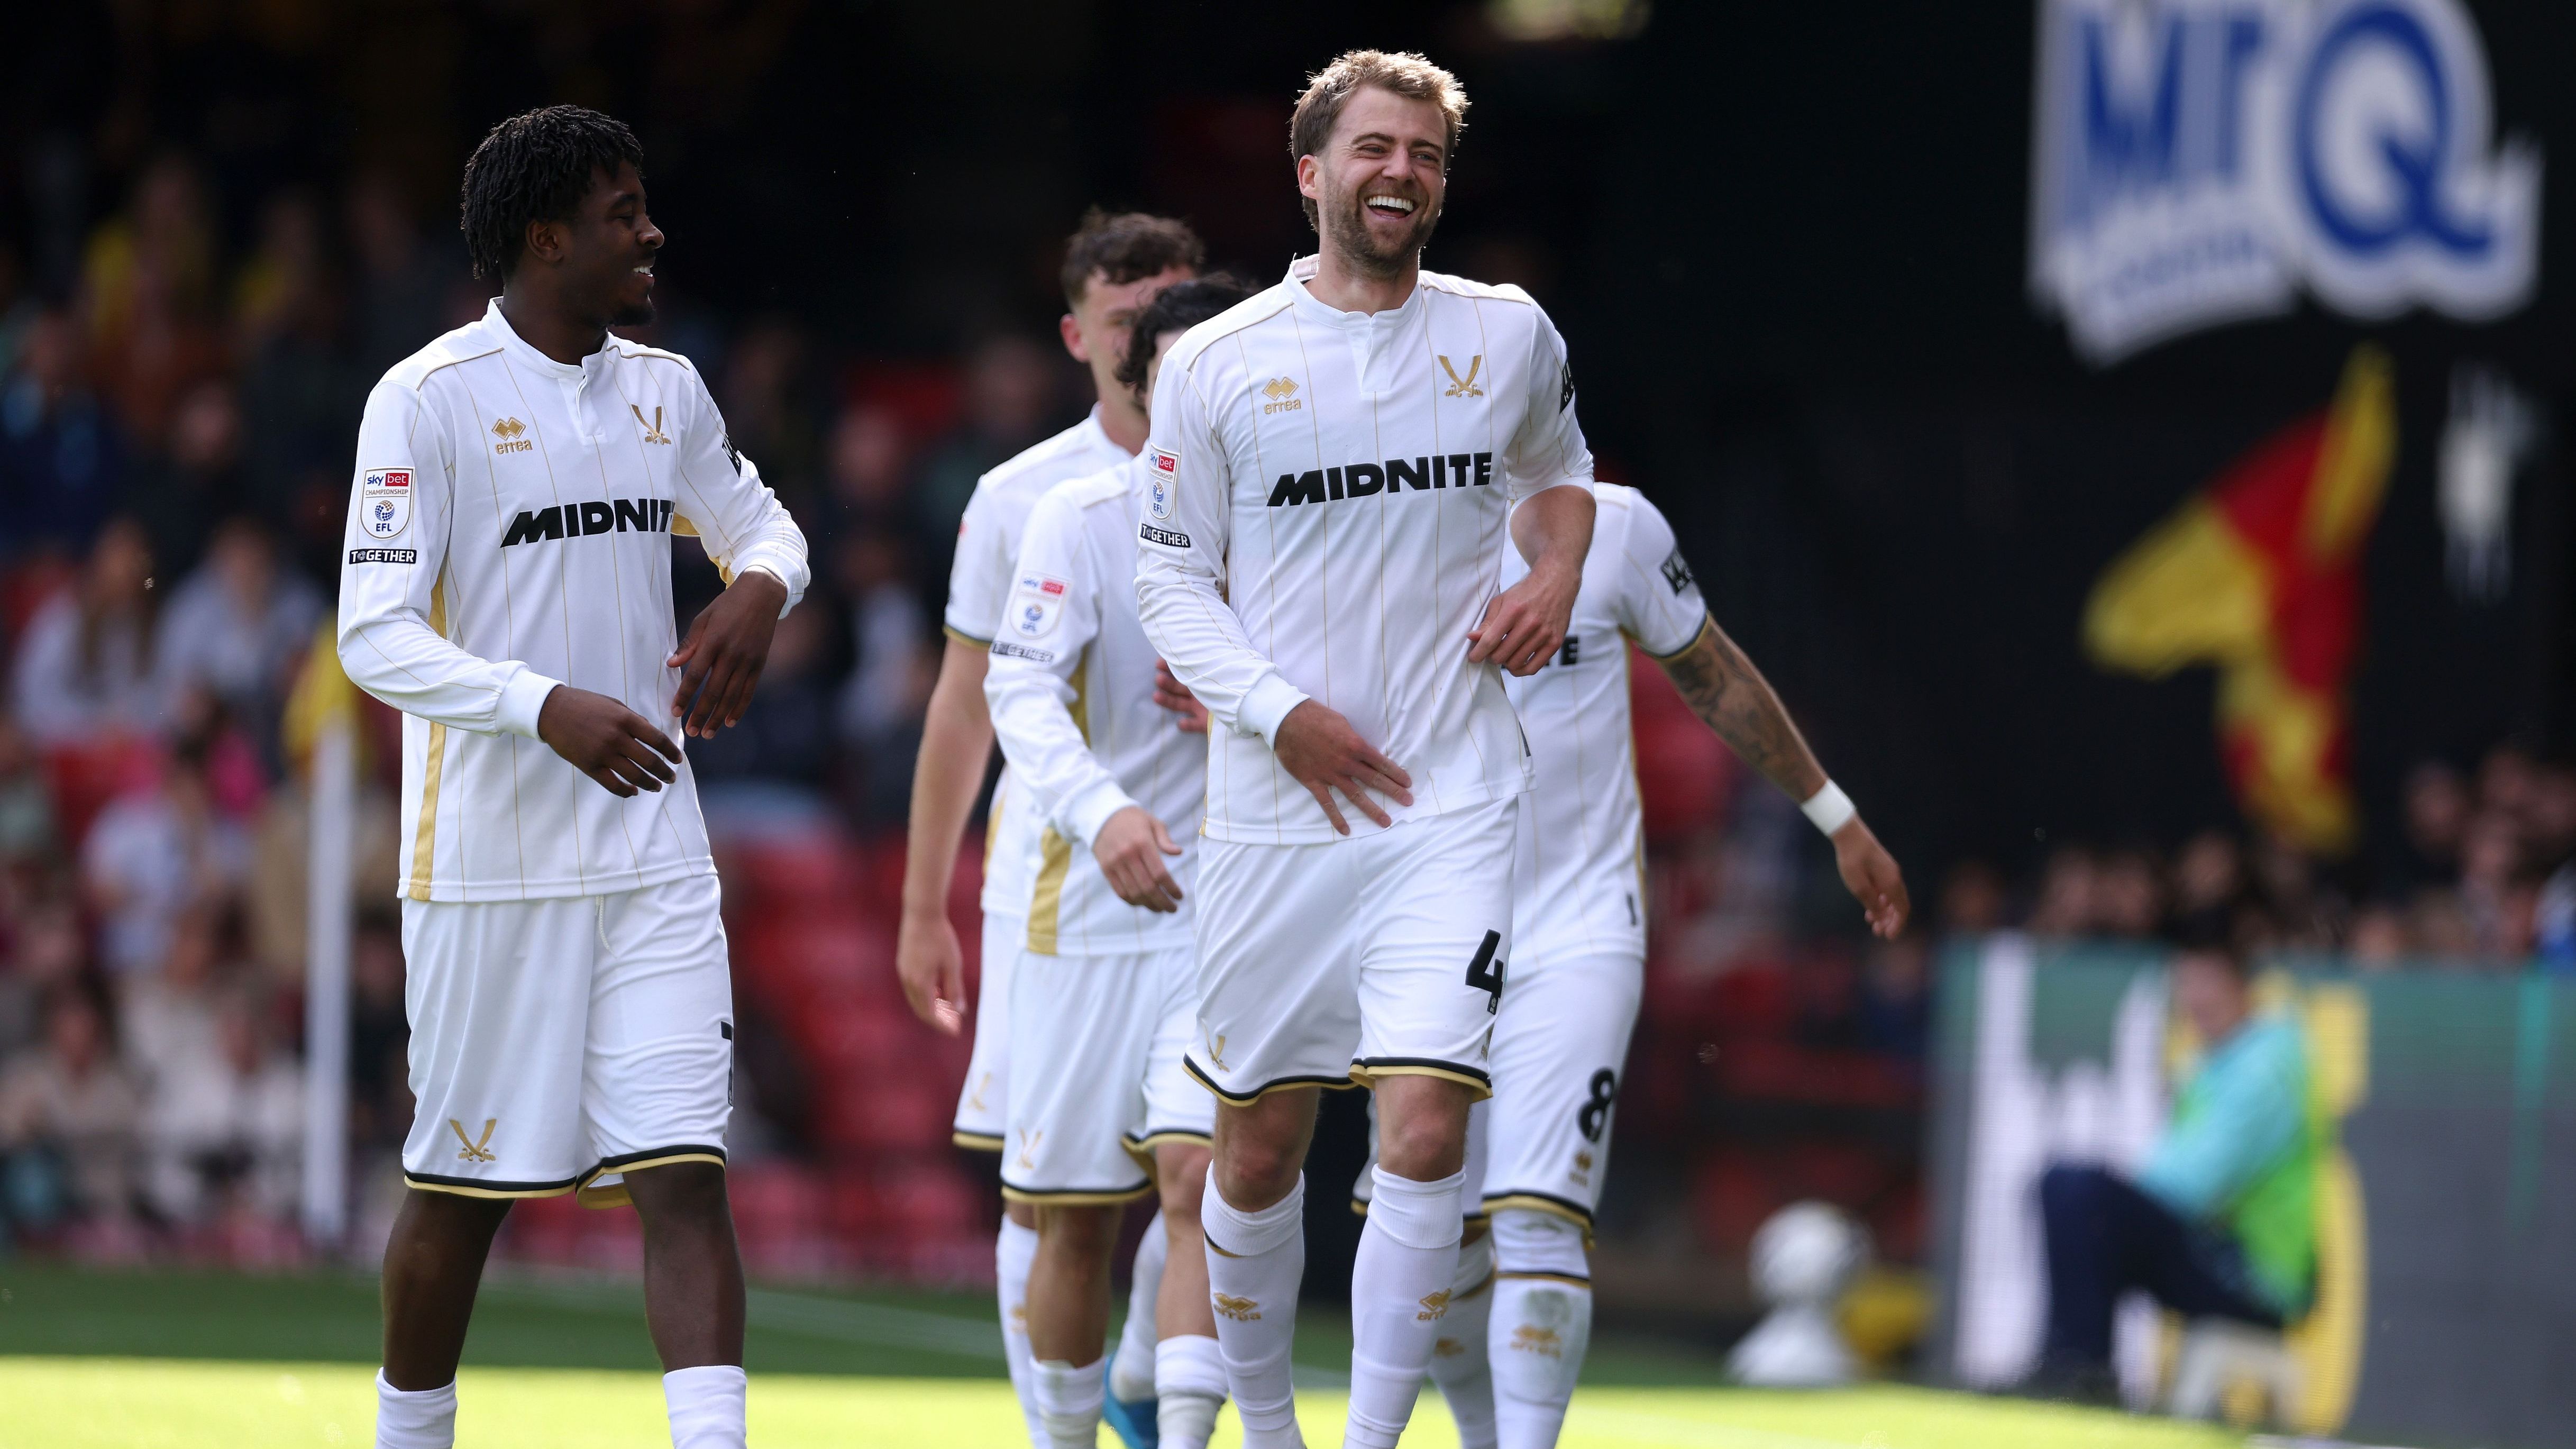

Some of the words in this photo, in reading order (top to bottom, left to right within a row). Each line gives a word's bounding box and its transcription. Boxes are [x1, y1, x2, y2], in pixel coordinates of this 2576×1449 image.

[1264, 399, 1301, 415] errea
[495, 439, 533, 454] errea
[1159, 457, 1173, 469] bet
[367, 475, 385, 486] sky
[387, 473, 407, 484] bet
[1266, 452, 1492, 507] MIDNITE
[1153, 502, 1164, 514] EFL
[376, 523, 392, 532] EFL
[500, 498, 675, 548] MIDNIT
[1466, 929, 1503, 1015] 4
[1576, 1067, 1614, 1145] 8
